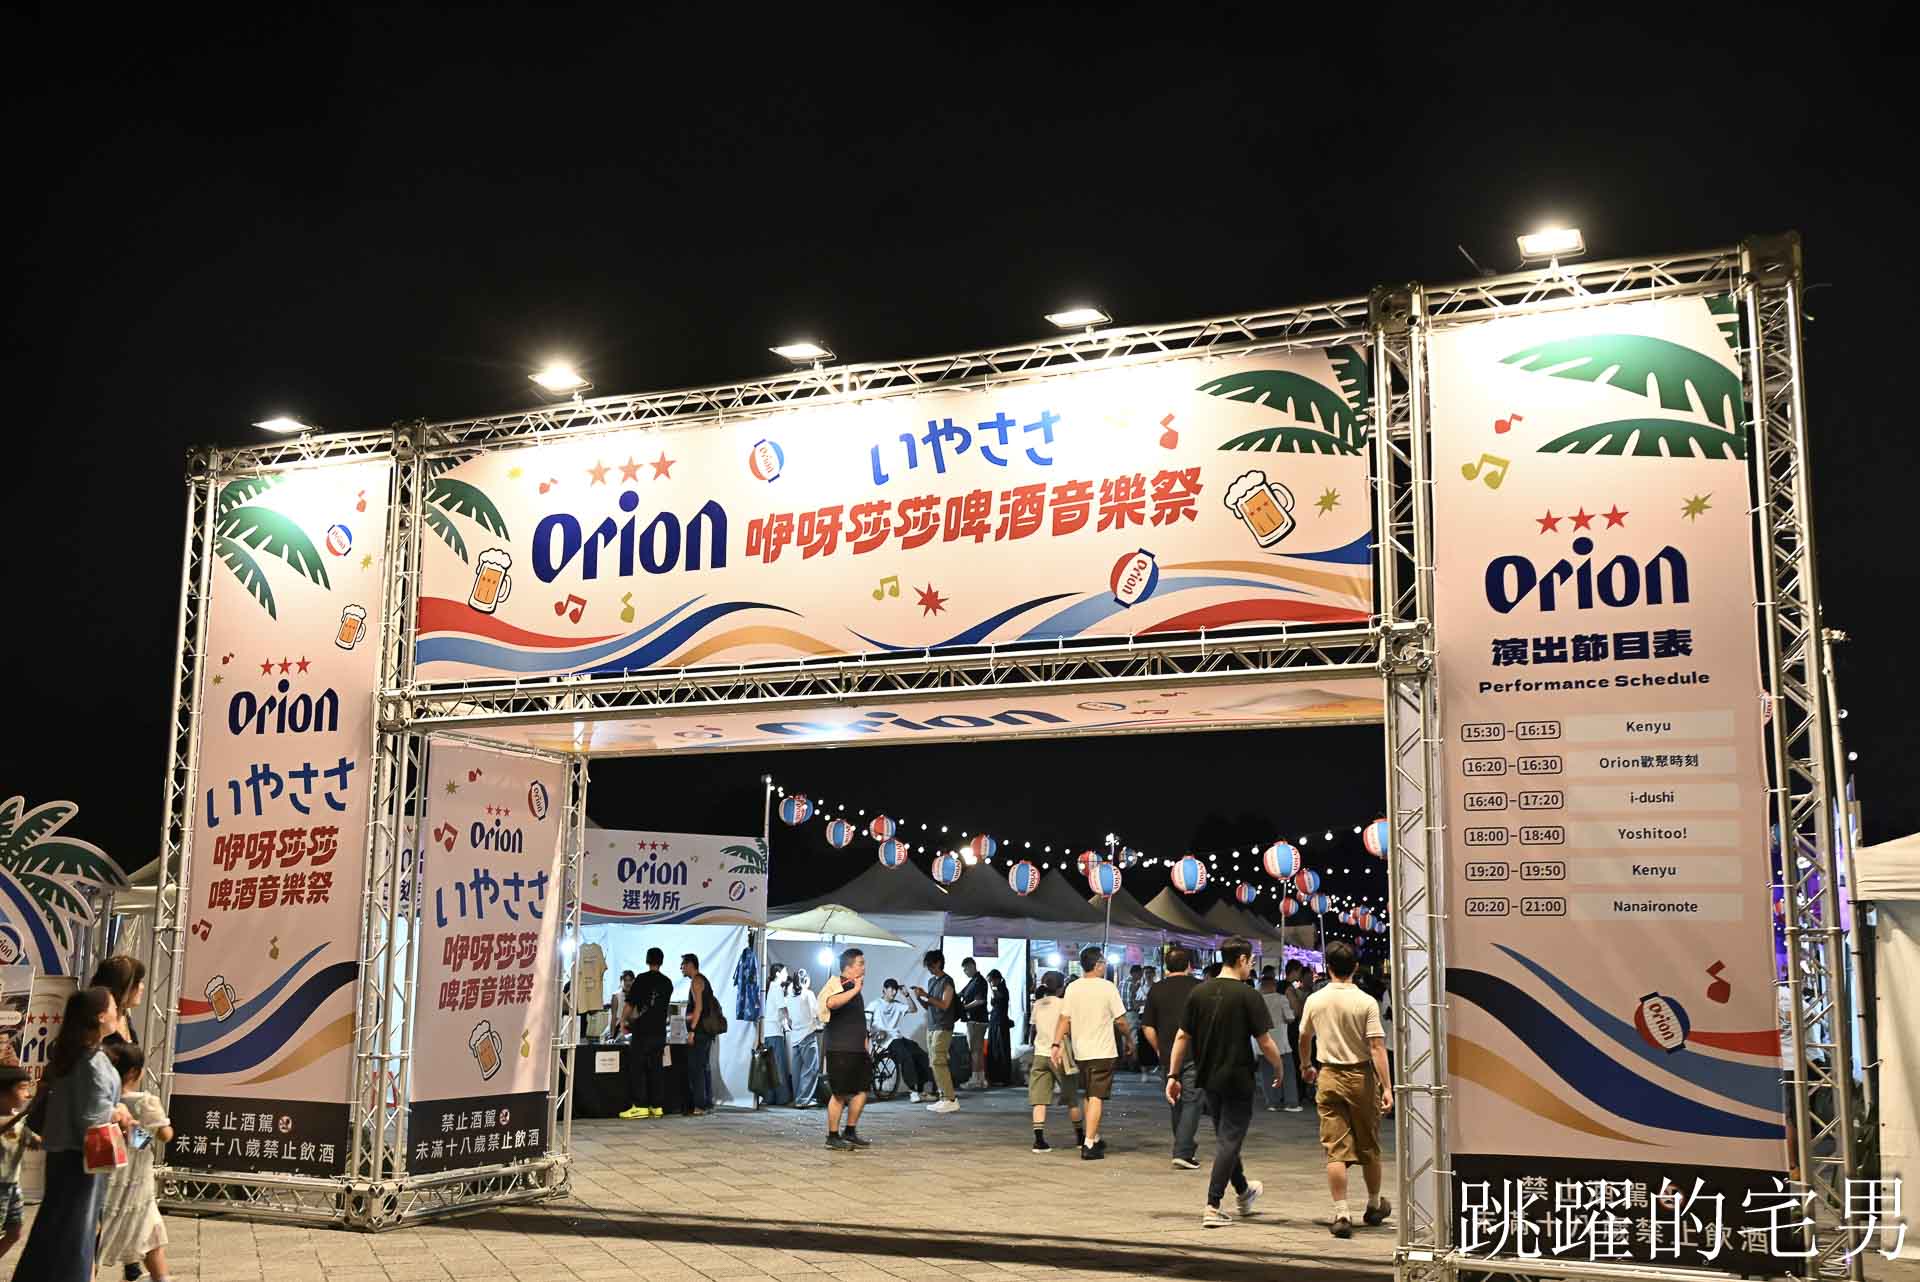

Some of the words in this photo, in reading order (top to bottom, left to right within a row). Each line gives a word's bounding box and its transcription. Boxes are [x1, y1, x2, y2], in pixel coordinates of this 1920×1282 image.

[871, 411, 1061, 486] いやささ
[745, 466, 1204, 564] 咿呀莎莎啤酒音樂祭
[532, 490, 728, 583] Orion
[1122, 560, 1147, 594] Orion
[1485, 537, 1689, 614] Orion
[1491, 628, 1693, 666] 演出節目表
[1479, 678, 1609, 694] Performance
[1615, 671, 1710, 688] Schedule
[228, 679, 339, 736] Orion
[1466, 725, 1500, 739] 15:30
[1521, 723, 1556, 737] 16:15
[1626, 719, 1672, 734] Kenyu
[1467, 760, 1501, 773] 16:20
[1522, 758, 1557, 772] 16:30
[207, 757, 354, 828] いやささ
[1468, 795, 1503, 808] 16:40
[1523, 793, 1559, 807] 17:20
[1630, 791, 1675, 804] i-dushi
[213, 826, 339, 871] 咿呀莎莎
[470, 818, 523, 854] Orion
[1469, 830, 1504, 843] 18:00
[1524, 828, 1560, 842] 18:40
[1618, 826, 1688, 840] Yoshitoo!
[617, 853, 688, 885] Orion
[1470, 865, 1505, 878] 19:20
[1525, 864, 1561, 878] 19:50
[1632, 863, 1677, 879] Kenyu
[208, 871, 333, 911] 啤酒音樂祭
[436, 868, 548, 928] いやささ
[623, 889, 680, 912] 選物所
[1470, 901, 1505, 914] 20:20
[1525, 900, 1562, 913] 21:00
[1613, 900, 1699, 914] Nanaironote
[443, 932, 538, 972] 咿呀莎莎
[438, 974, 534, 1012] 啤酒音樂祭
[1649, 1003, 1674, 1040] Orion
[205, 1110, 273, 1133] 禁止酒駕
[441, 1109, 497, 1133] 禁止酒駕
[176, 1134, 335, 1164] 未滿十八歲禁止飲酒
[415, 1128, 540, 1160] 未滿十八歲禁止飲酒
